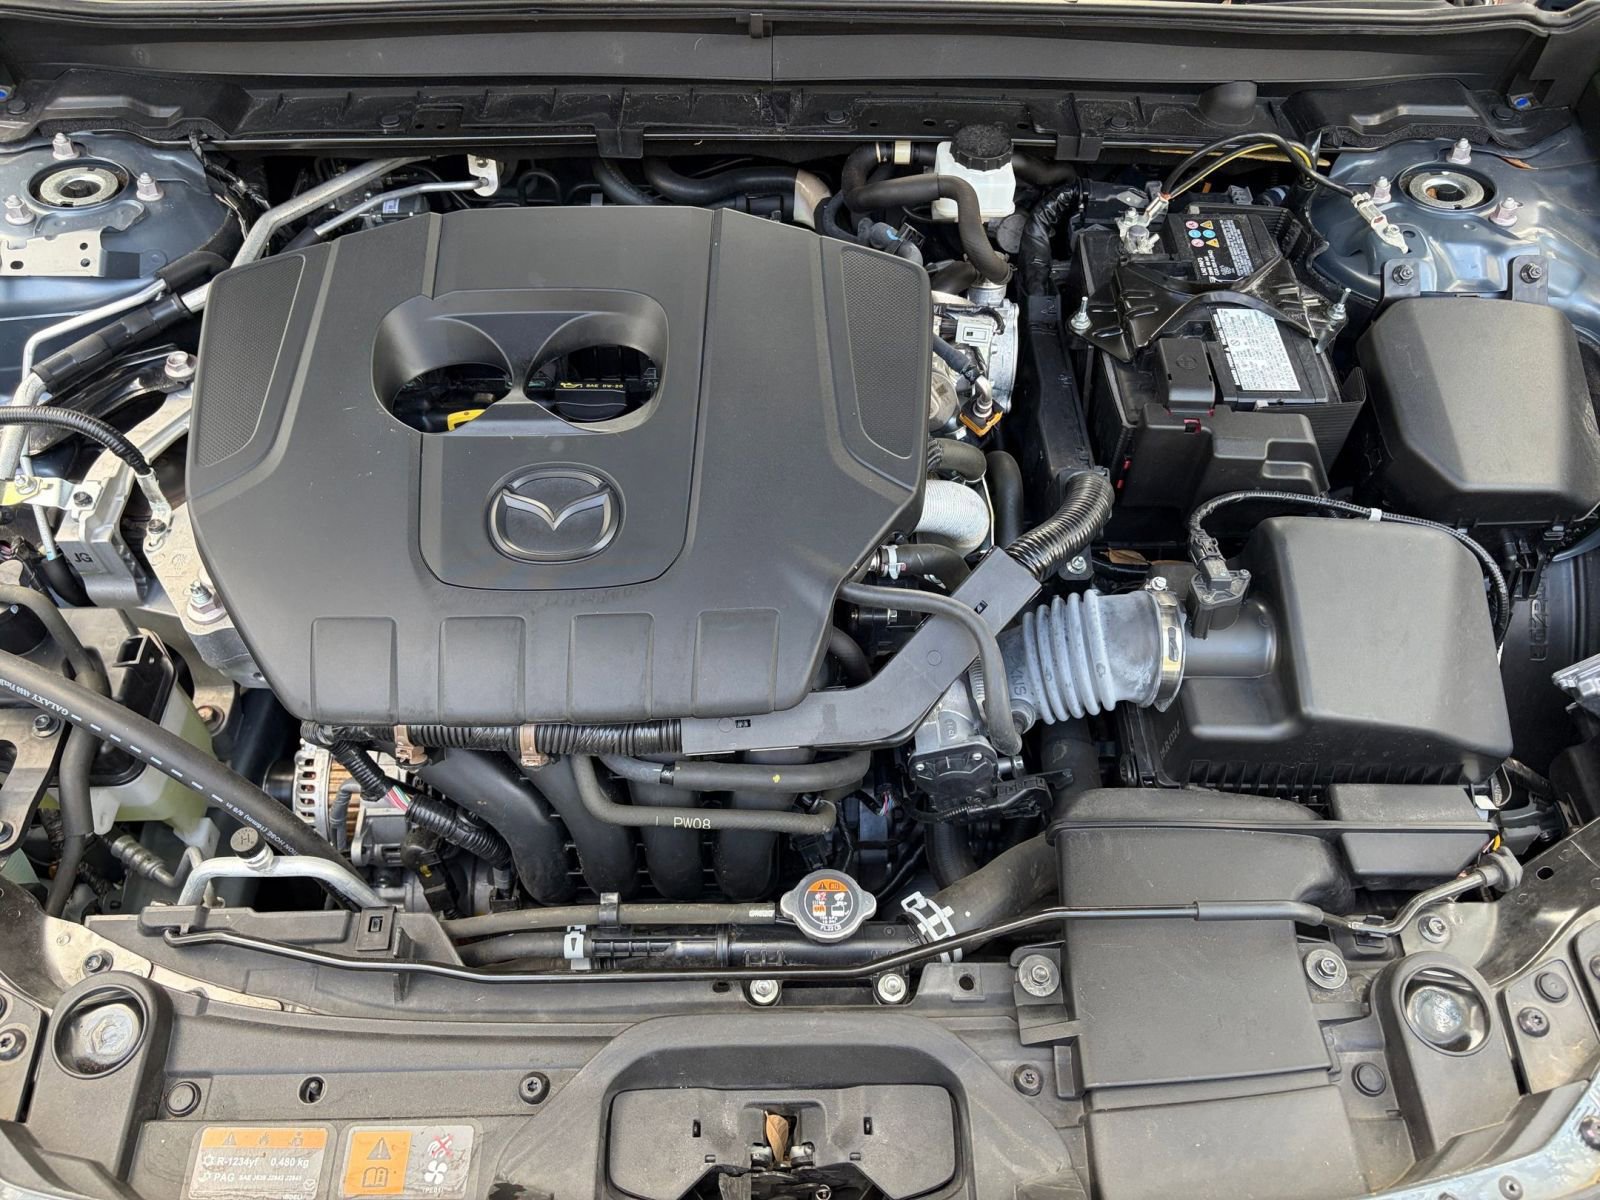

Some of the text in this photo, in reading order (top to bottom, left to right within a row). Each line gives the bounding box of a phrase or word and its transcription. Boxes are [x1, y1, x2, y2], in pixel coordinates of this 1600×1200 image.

[31, 693, 69, 716] GALAXY
[243, 814, 268, 833] (16mm)
[673, 816, 711, 830] PW08
[266, 830, 285, 846] HOSE
[216, 1157, 310, 1169] R-1234yf 0.480 kg
[213, 1172, 235, 1182] PAG
